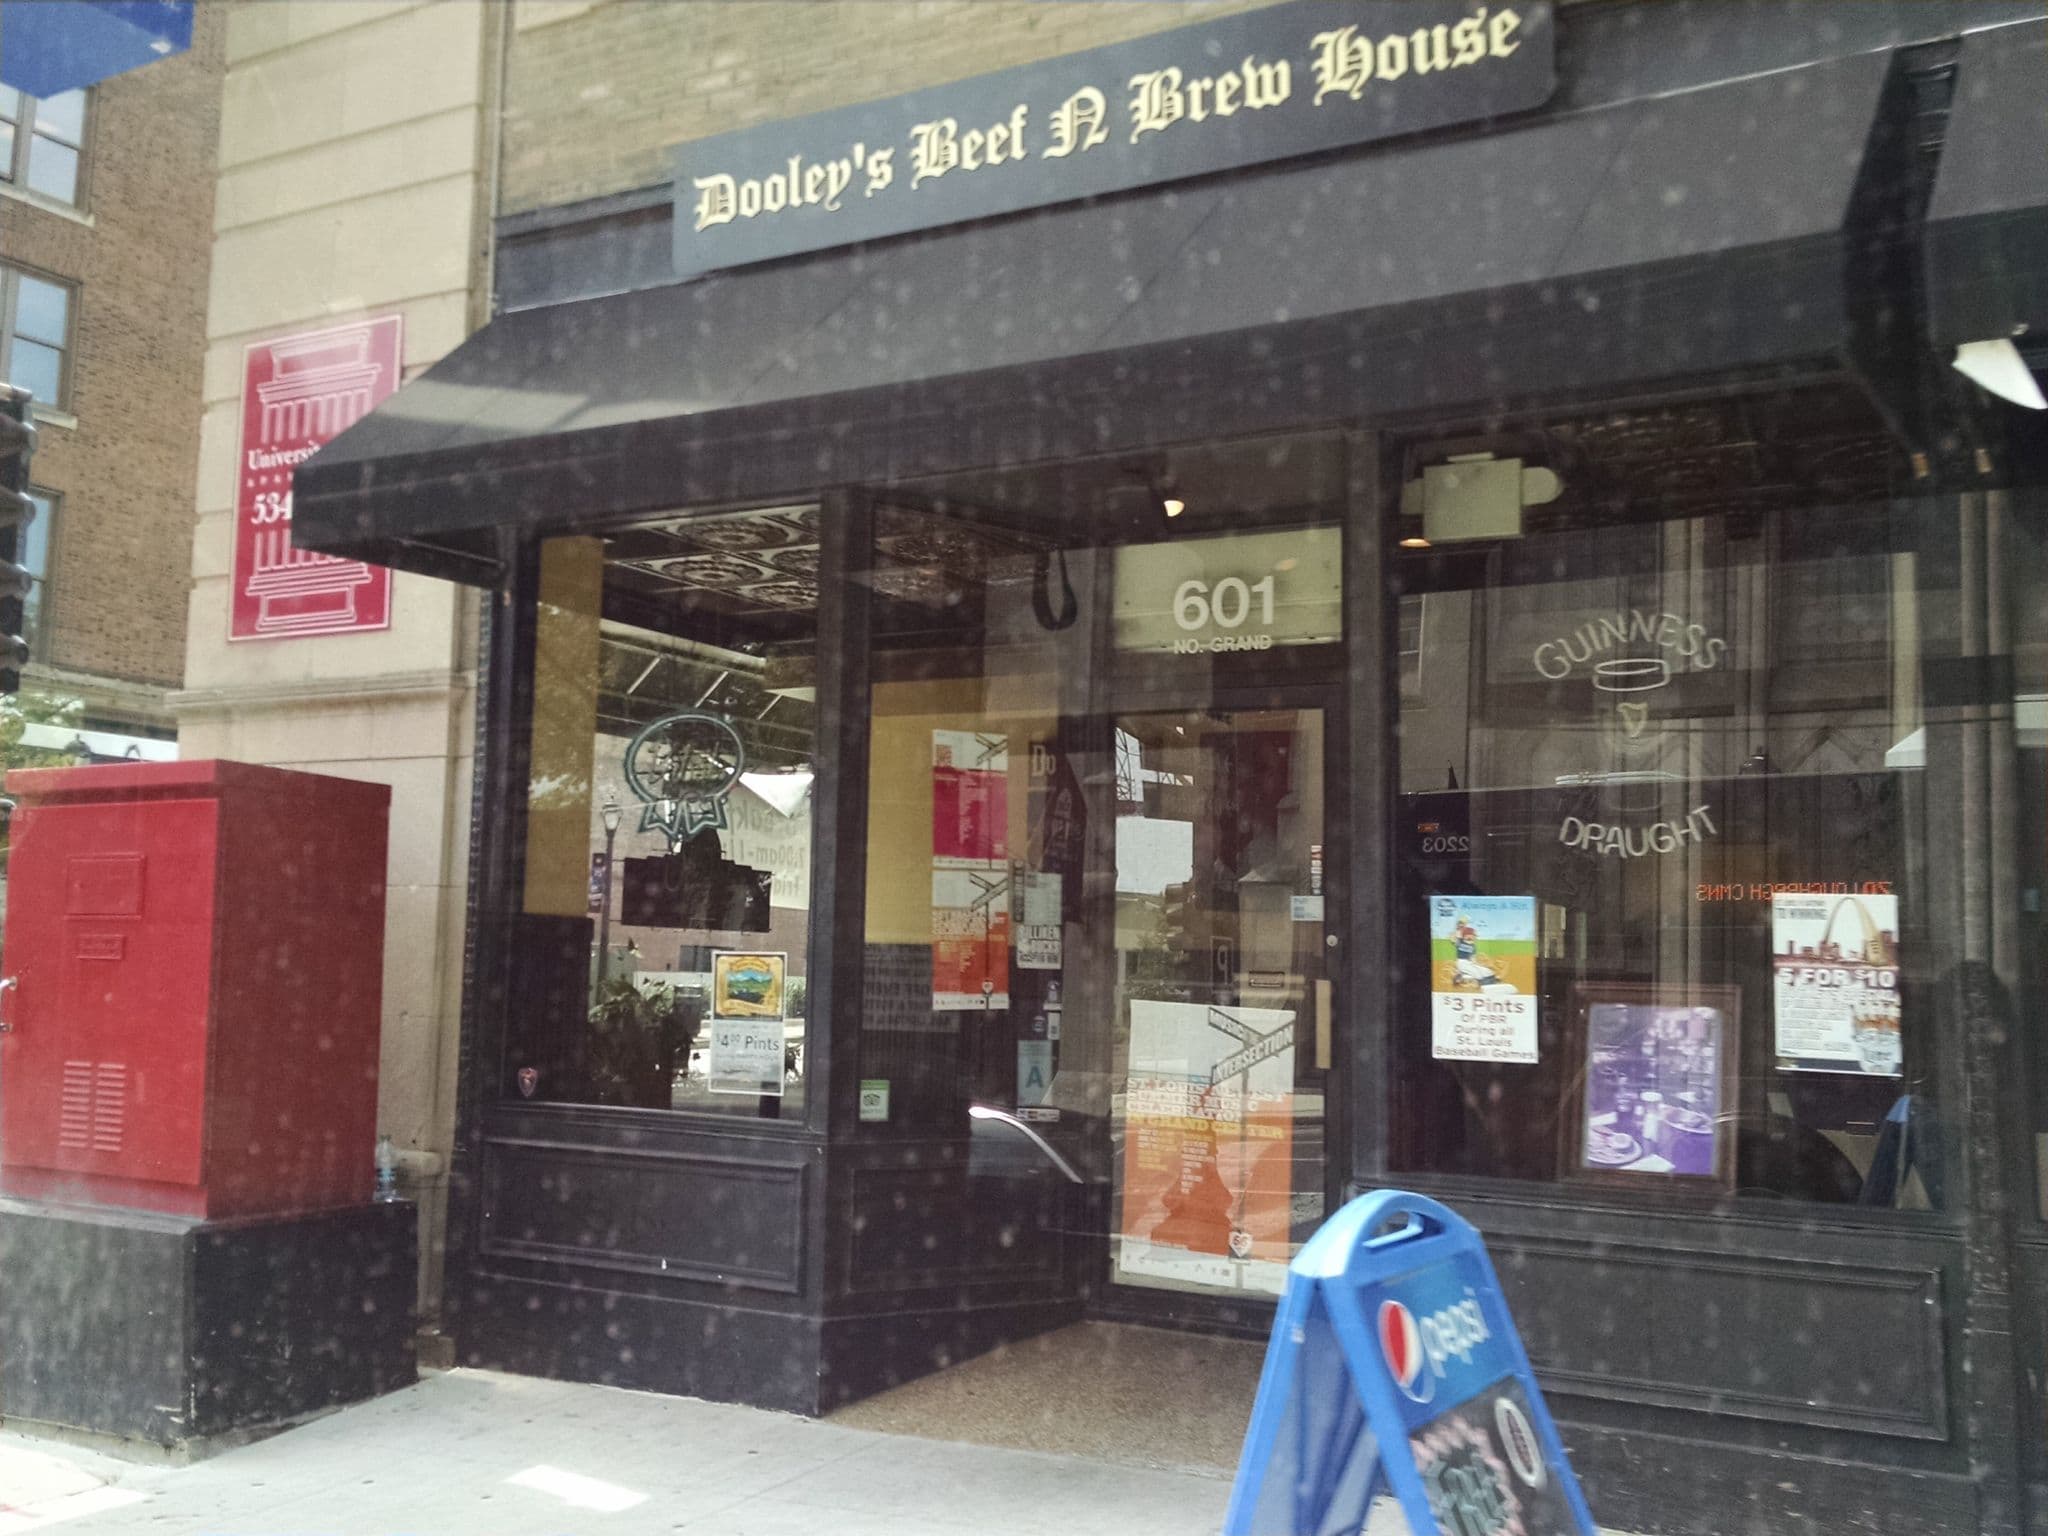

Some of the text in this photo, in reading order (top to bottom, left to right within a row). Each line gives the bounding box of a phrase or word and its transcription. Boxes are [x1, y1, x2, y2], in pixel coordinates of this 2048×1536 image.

[693, 7, 1522, 232] Dooley's Beef N Brew House
[1173, 575, 1275, 631] 601
[1174, 634, 1273, 655] NO. GRAND
[1533, 609, 1728, 679] GUINNESS
[1559, 805, 1718, 858] DRAUGHT
[1801, 969, 1849, 988] FOR
[1854, 969, 1896, 989] $10
[1472, 998, 1525, 1014] Pints
[1455, 1025, 1496, 1037] During
[745, 1035, 780, 1051] Pints
[1434, 1046, 1489, 1058] Baseball
[1479, 1037, 1513, 1048] Louis
[1025, 1066, 1045, 1088] A
[1420, 1286, 1490, 1378] pepsi
